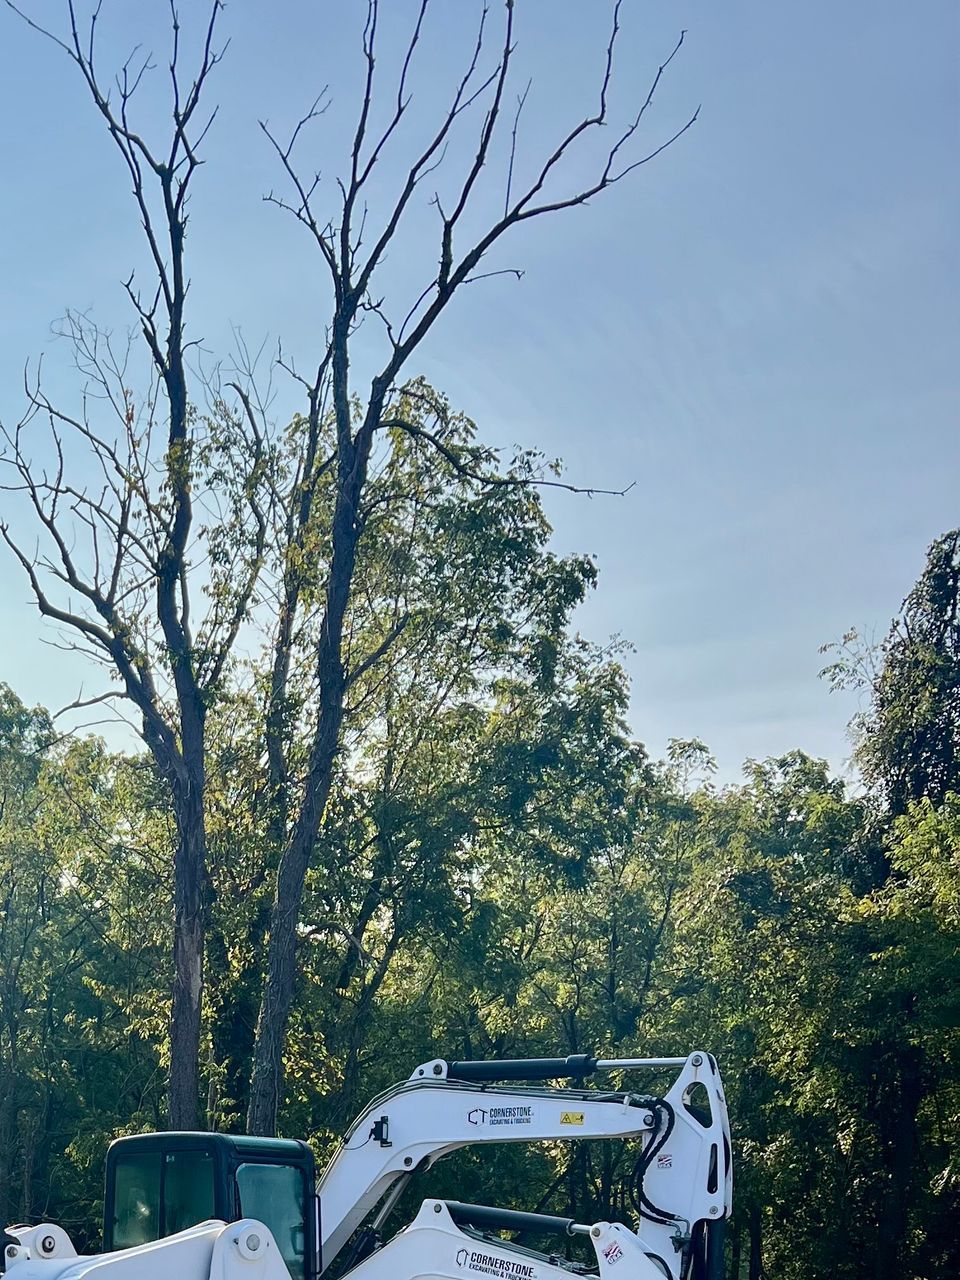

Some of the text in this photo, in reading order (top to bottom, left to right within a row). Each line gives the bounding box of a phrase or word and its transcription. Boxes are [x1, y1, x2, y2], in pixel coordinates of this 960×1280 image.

[489, 1106, 532, 1118] CORNERSTONE
[468, 1263, 500, 1277] EXCAVATING
[470, 1252, 535, 1278] CORNERSTONE
